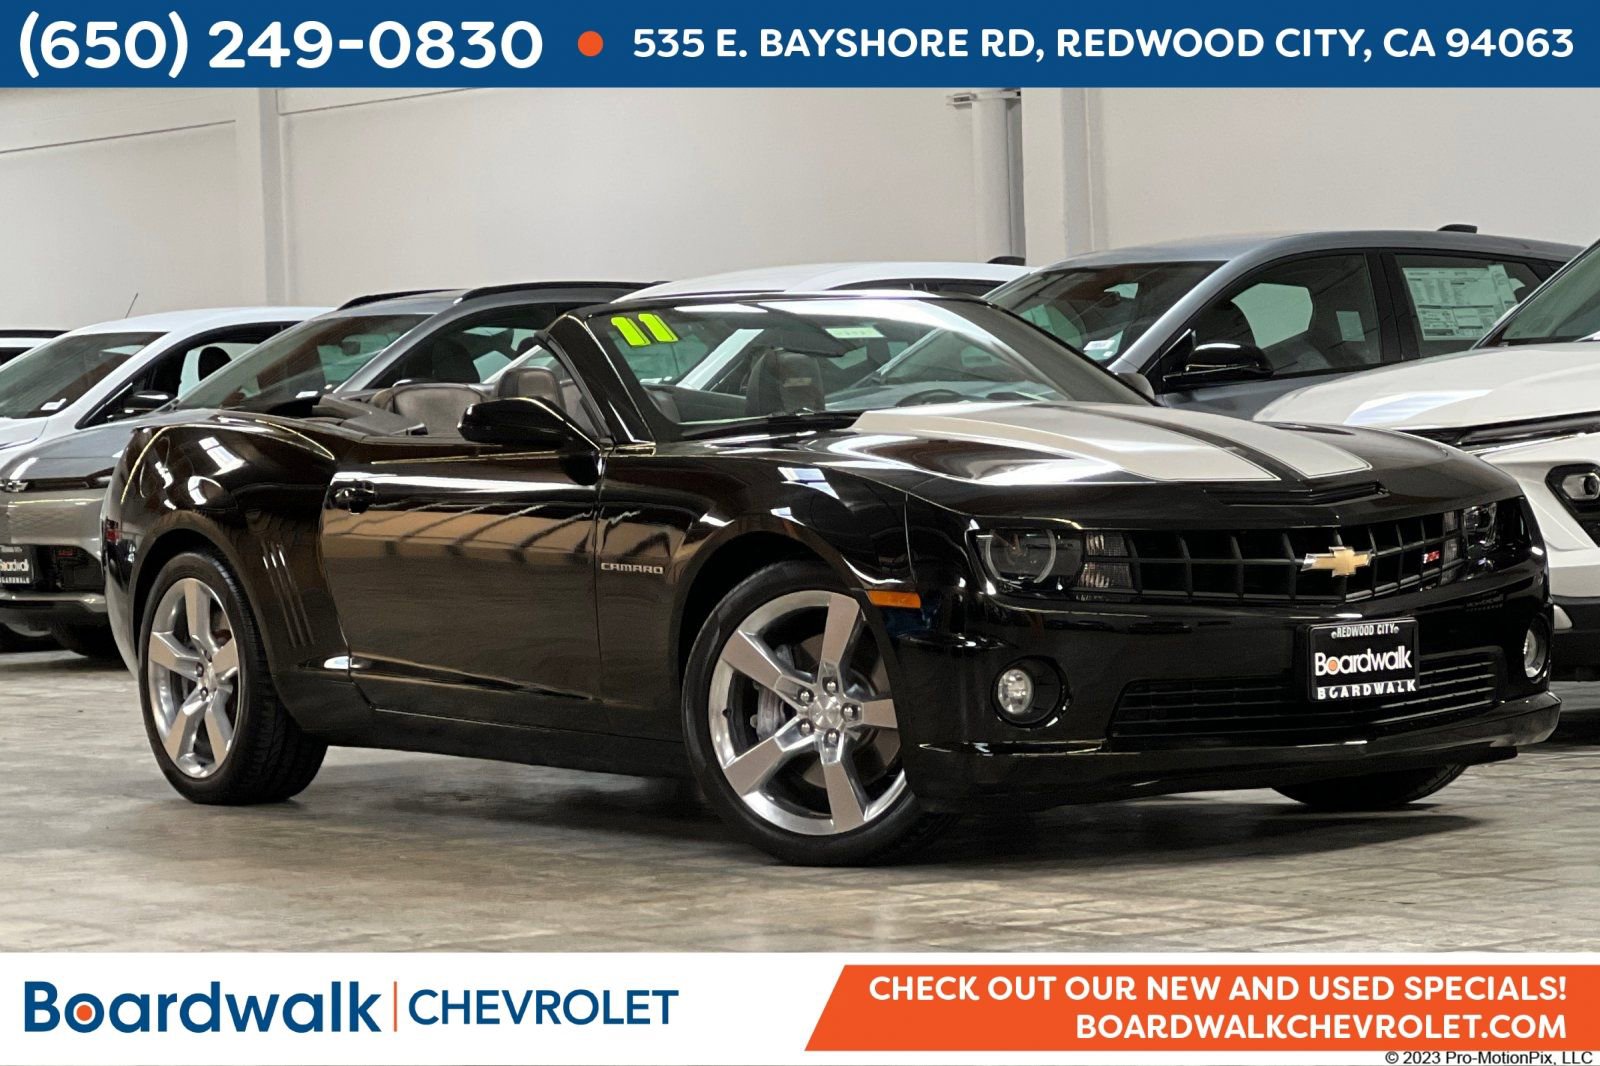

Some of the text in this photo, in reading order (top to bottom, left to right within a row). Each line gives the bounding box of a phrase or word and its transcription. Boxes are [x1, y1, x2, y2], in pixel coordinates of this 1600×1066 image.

[610, 312, 680, 348] 11
[600, 561, 664, 575] CAMARO
[1336, 623, 1395, 638] REDWOOD CITY
[1314, 645, 1413, 677] Boardwalk
